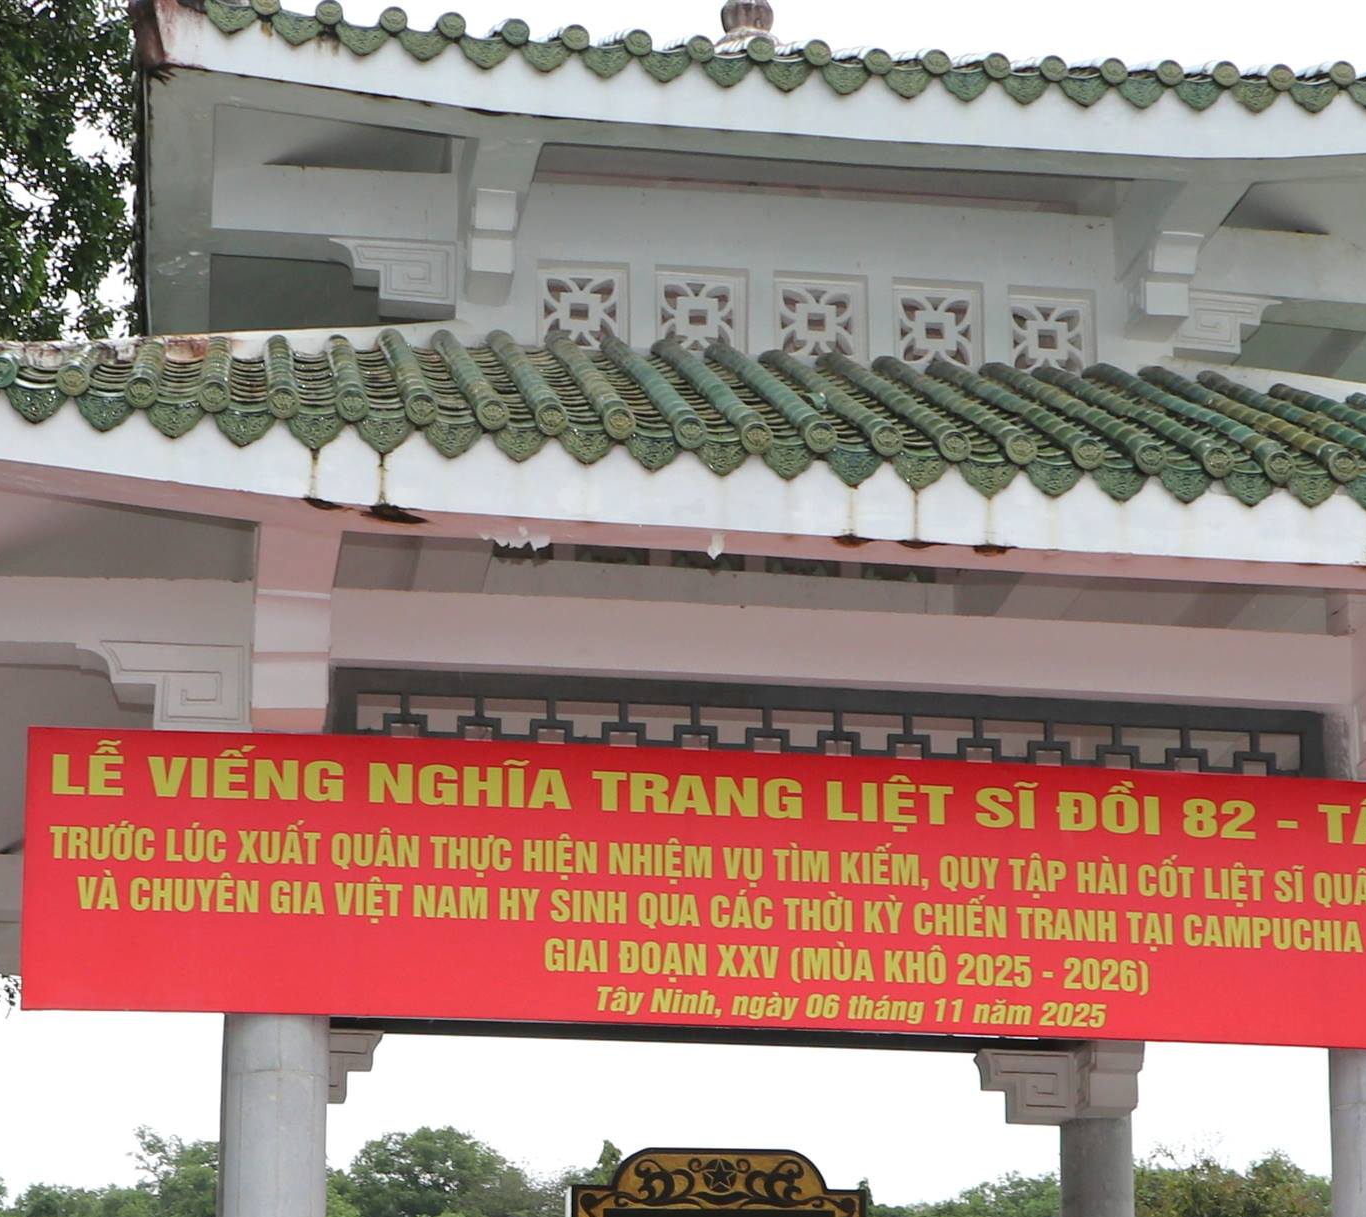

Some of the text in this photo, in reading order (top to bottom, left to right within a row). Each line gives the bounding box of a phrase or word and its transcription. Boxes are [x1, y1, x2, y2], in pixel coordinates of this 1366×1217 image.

[51, 739, 125, 797] LỄ
[147, 745, 344, 802] VIẾNG
[368, 759, 572, 810] NGHĨA
[591, 770, 803, 820] TRANG
[826, 774, 954, 833] LIỆT
[975, 781, 1037, 830] SĨ
[1055, 780, 1161, 836] ĐỒI
[1182, 798, 1257, 840] 82
[1276, 819, 1299, 829] -
[49, 819, 156, 862] TRƯỚC
[165, 821, 228, 864] LÚC
[237, 819, 322, 865] XUẤT
[330, 826, 420, 870] QUÂN
[429, 834, 513, 878] THỰC
[522, 832, 599, 881] HIỆN
[608, 837, 713, 885] NHIỆM
[722, 847, 764, 888] VỤ
[772, 843, 831, 883] TÌM
[839, 844, 930, 890] KIẾM,
[939, 854, 1000, 892] QUY
[1008, 852, 1068, 900] TẬP
[1076, 856, 1129, 896] HÀI
[1137, 856, 1196, 898] CỐT
[1203, 861, 1265, 908] LIỆT
[1273, 864, 1305, 903] SĨ
[76, 869, 120, 911] VÀ
[129, 871, 260, 913] CHUYÊN
[269, 879, 325, 914] GIA
[333, 875, 404, 925] VIỆT
[412, 884, 489, 920] NAM
[498, 887, 540, 922] HY
[549, 888, 628, 925] SINH
[637, 891, 701, 930] QUA
[709, 889, 774, 931] CÁC
[782, 891, 854, 933] THỜI
[862, 895, 904, 934] KỲ
[912, 895, 1008, 939] CHIẾN
[1015, 906, 1118, 944] TRANH
[1125, 911, 1174, 952] TẠI
[1182, 913, 1364, 953] CAMPUCHIA
[543, 937, 1150, 996] GIAI ĐOẠN XXV (MÙA KHÔ 2025 - 2026)
[596, 985, 1108, 1029] Tây Ninh, ngày 06 tháng 11 năm 2025
